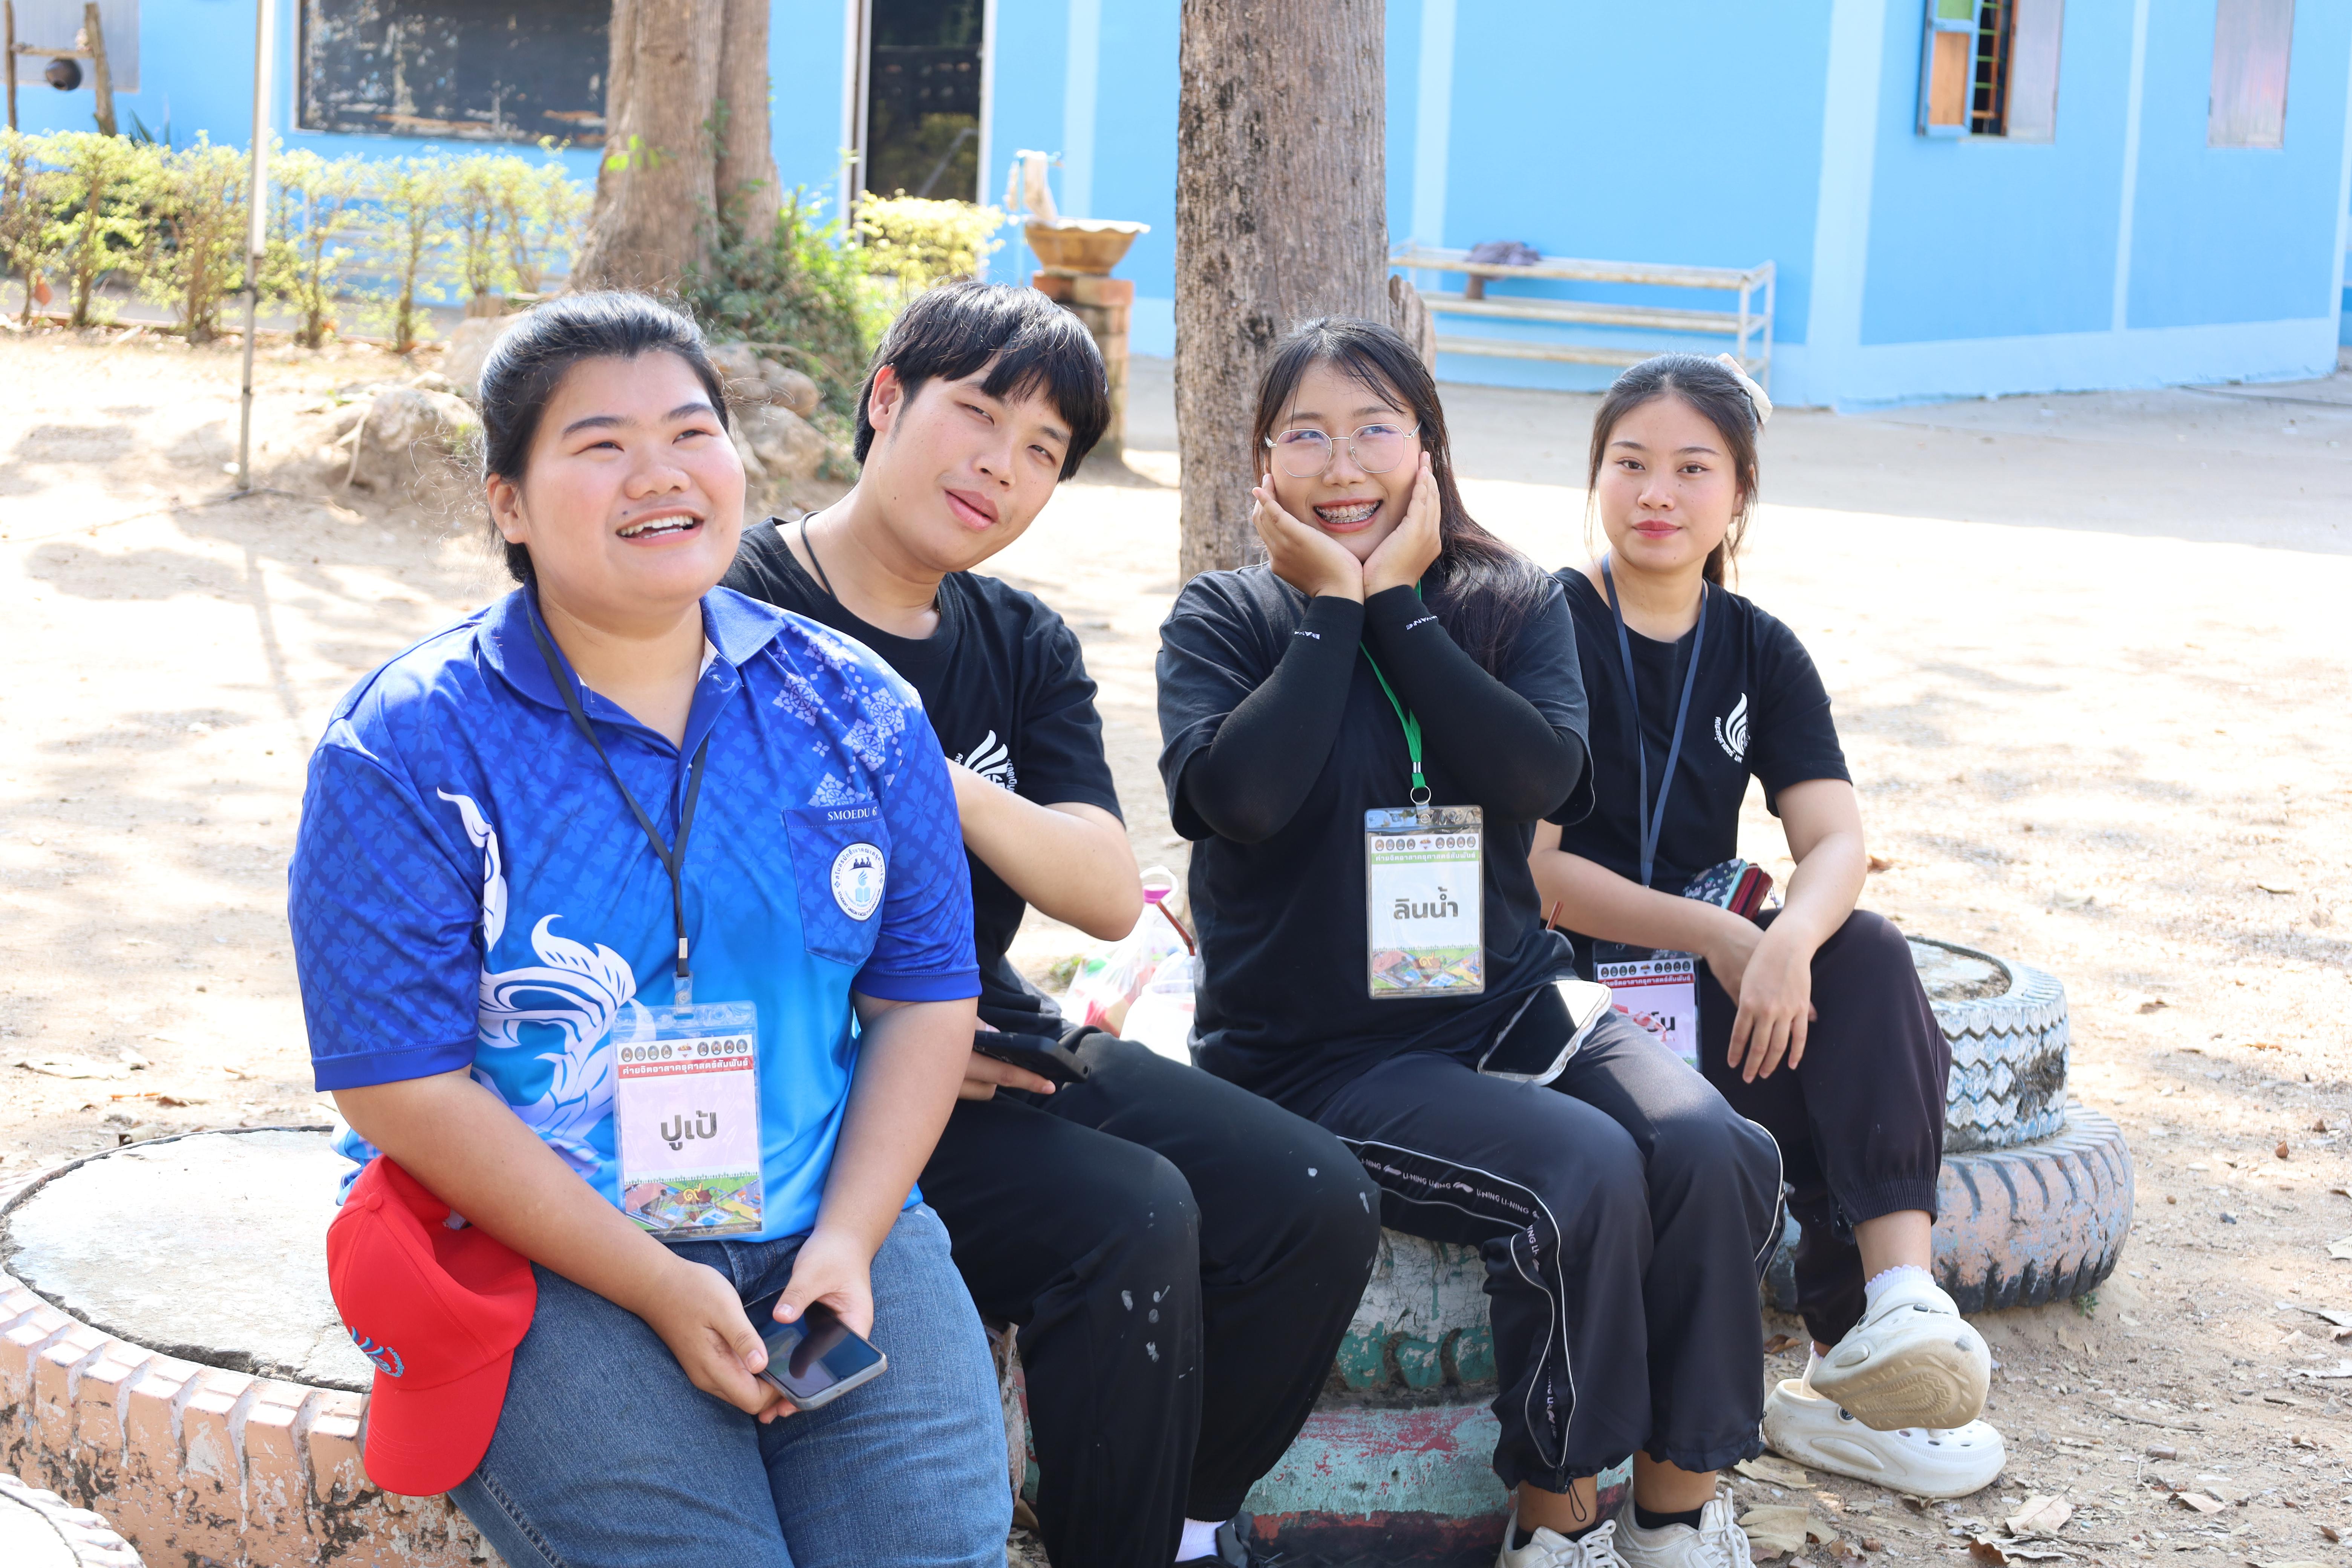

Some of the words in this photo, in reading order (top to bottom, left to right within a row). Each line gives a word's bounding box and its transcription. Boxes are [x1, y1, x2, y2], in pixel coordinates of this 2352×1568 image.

[828, 808, 870, 821] SMOEDU
[1393, 887, 1458, 920] ลินน้ำ
[623, 1058, 749, 1075] ค่ายจิตอาสาครุศาสตร์สัมพันธ์
[661, 1110, 717, 1151] ปูเป้
[1403, 1173, 1427, 1185] LI-NING
[1501, 1197, 1529, 1214] LI-NING
